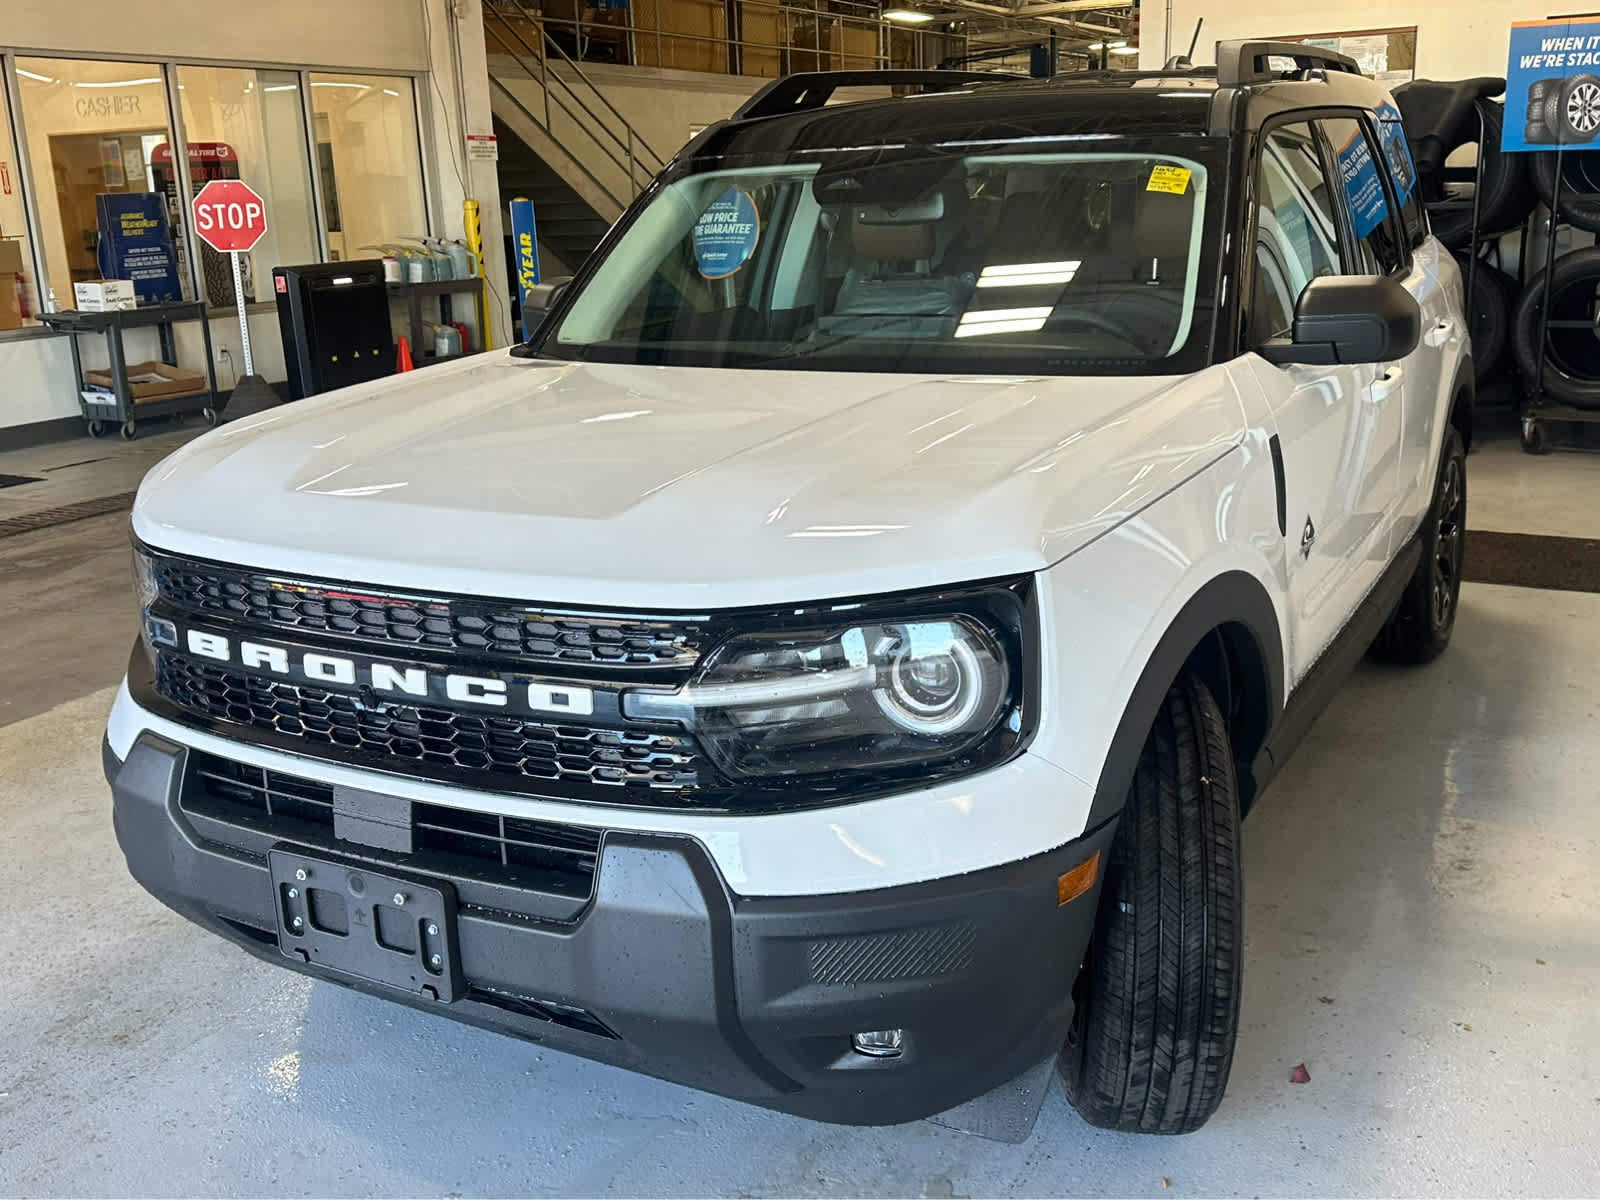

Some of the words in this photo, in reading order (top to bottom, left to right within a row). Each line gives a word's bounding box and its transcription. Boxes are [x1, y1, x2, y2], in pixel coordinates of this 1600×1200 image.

[1541, 36, 1585, 52] WHEN
[1586, 35, 1600, 50] IT
[1520, 53, 1566, 69] WE'RE
[1567, 51, 1600, 66] STAC
[75, 95, 141, 117] CASHIER
[198, 203, 260, 230] STOP
[713, 212, 739, 222] PRICE
[187, 629, 594, 715] BRONCO
